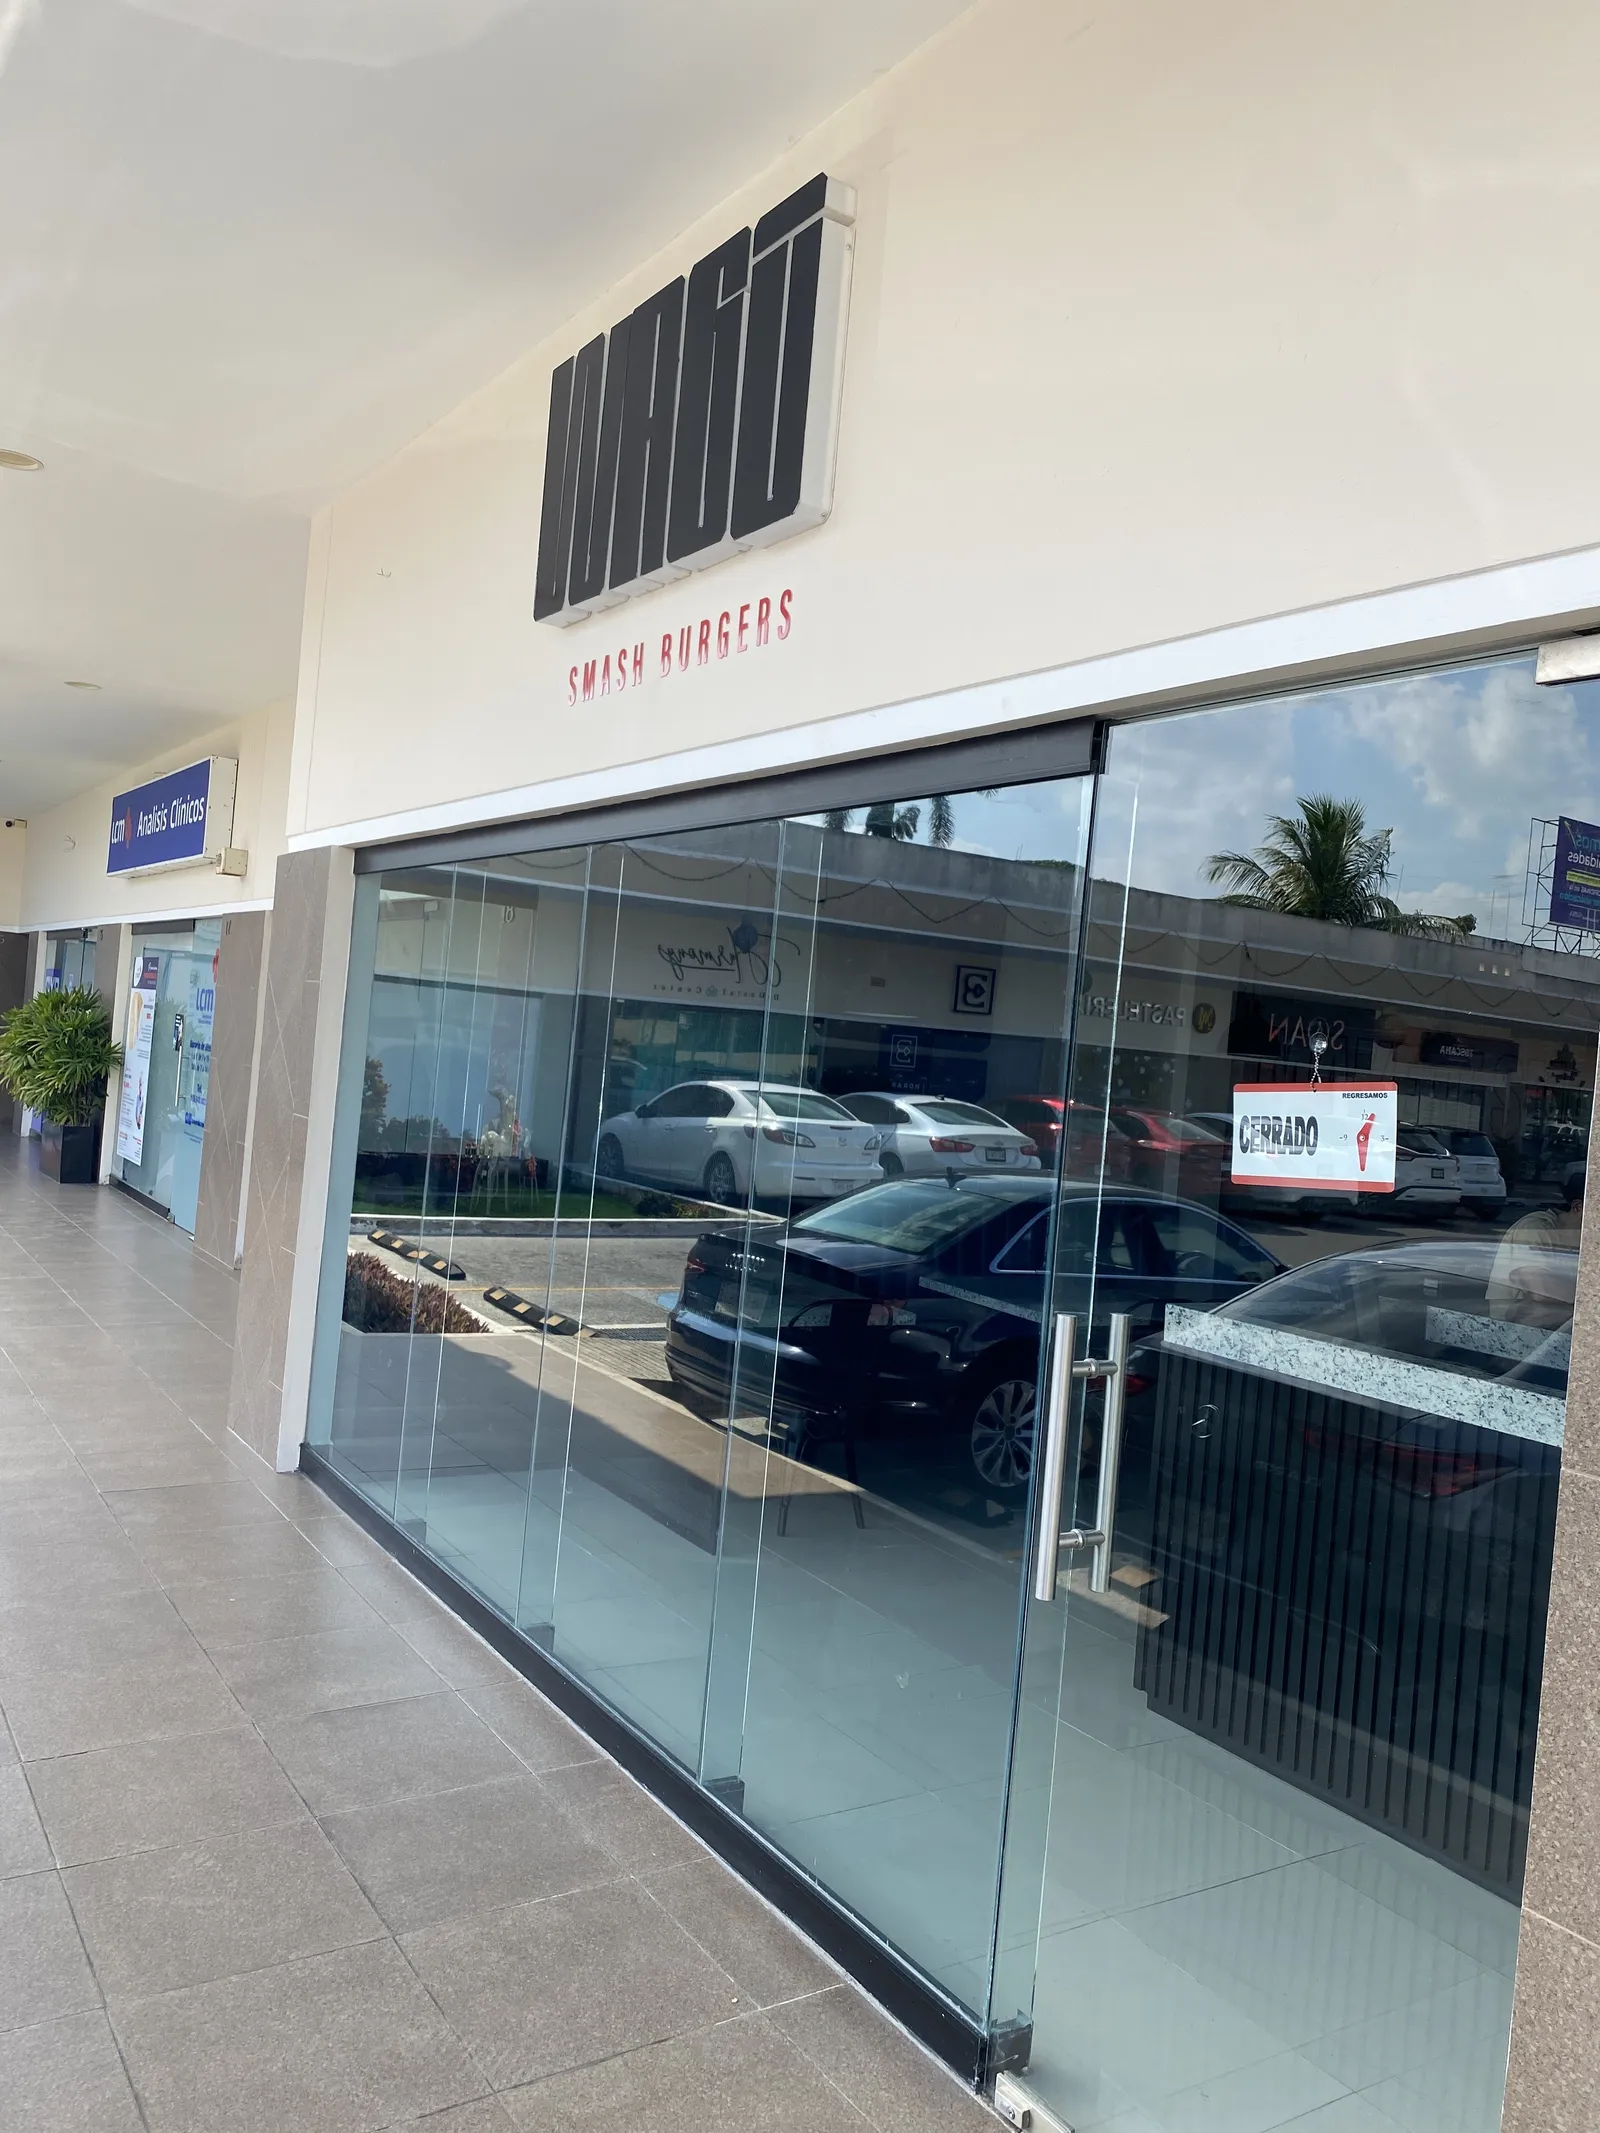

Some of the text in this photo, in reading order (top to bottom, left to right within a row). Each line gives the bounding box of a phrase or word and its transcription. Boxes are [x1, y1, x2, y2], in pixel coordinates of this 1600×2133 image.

[567, 588, 795, 707] SMASH BURGERS
[170, 794, 205, 829] Clínicos
[1239, 1115, 1319, 1156] CERRADO
